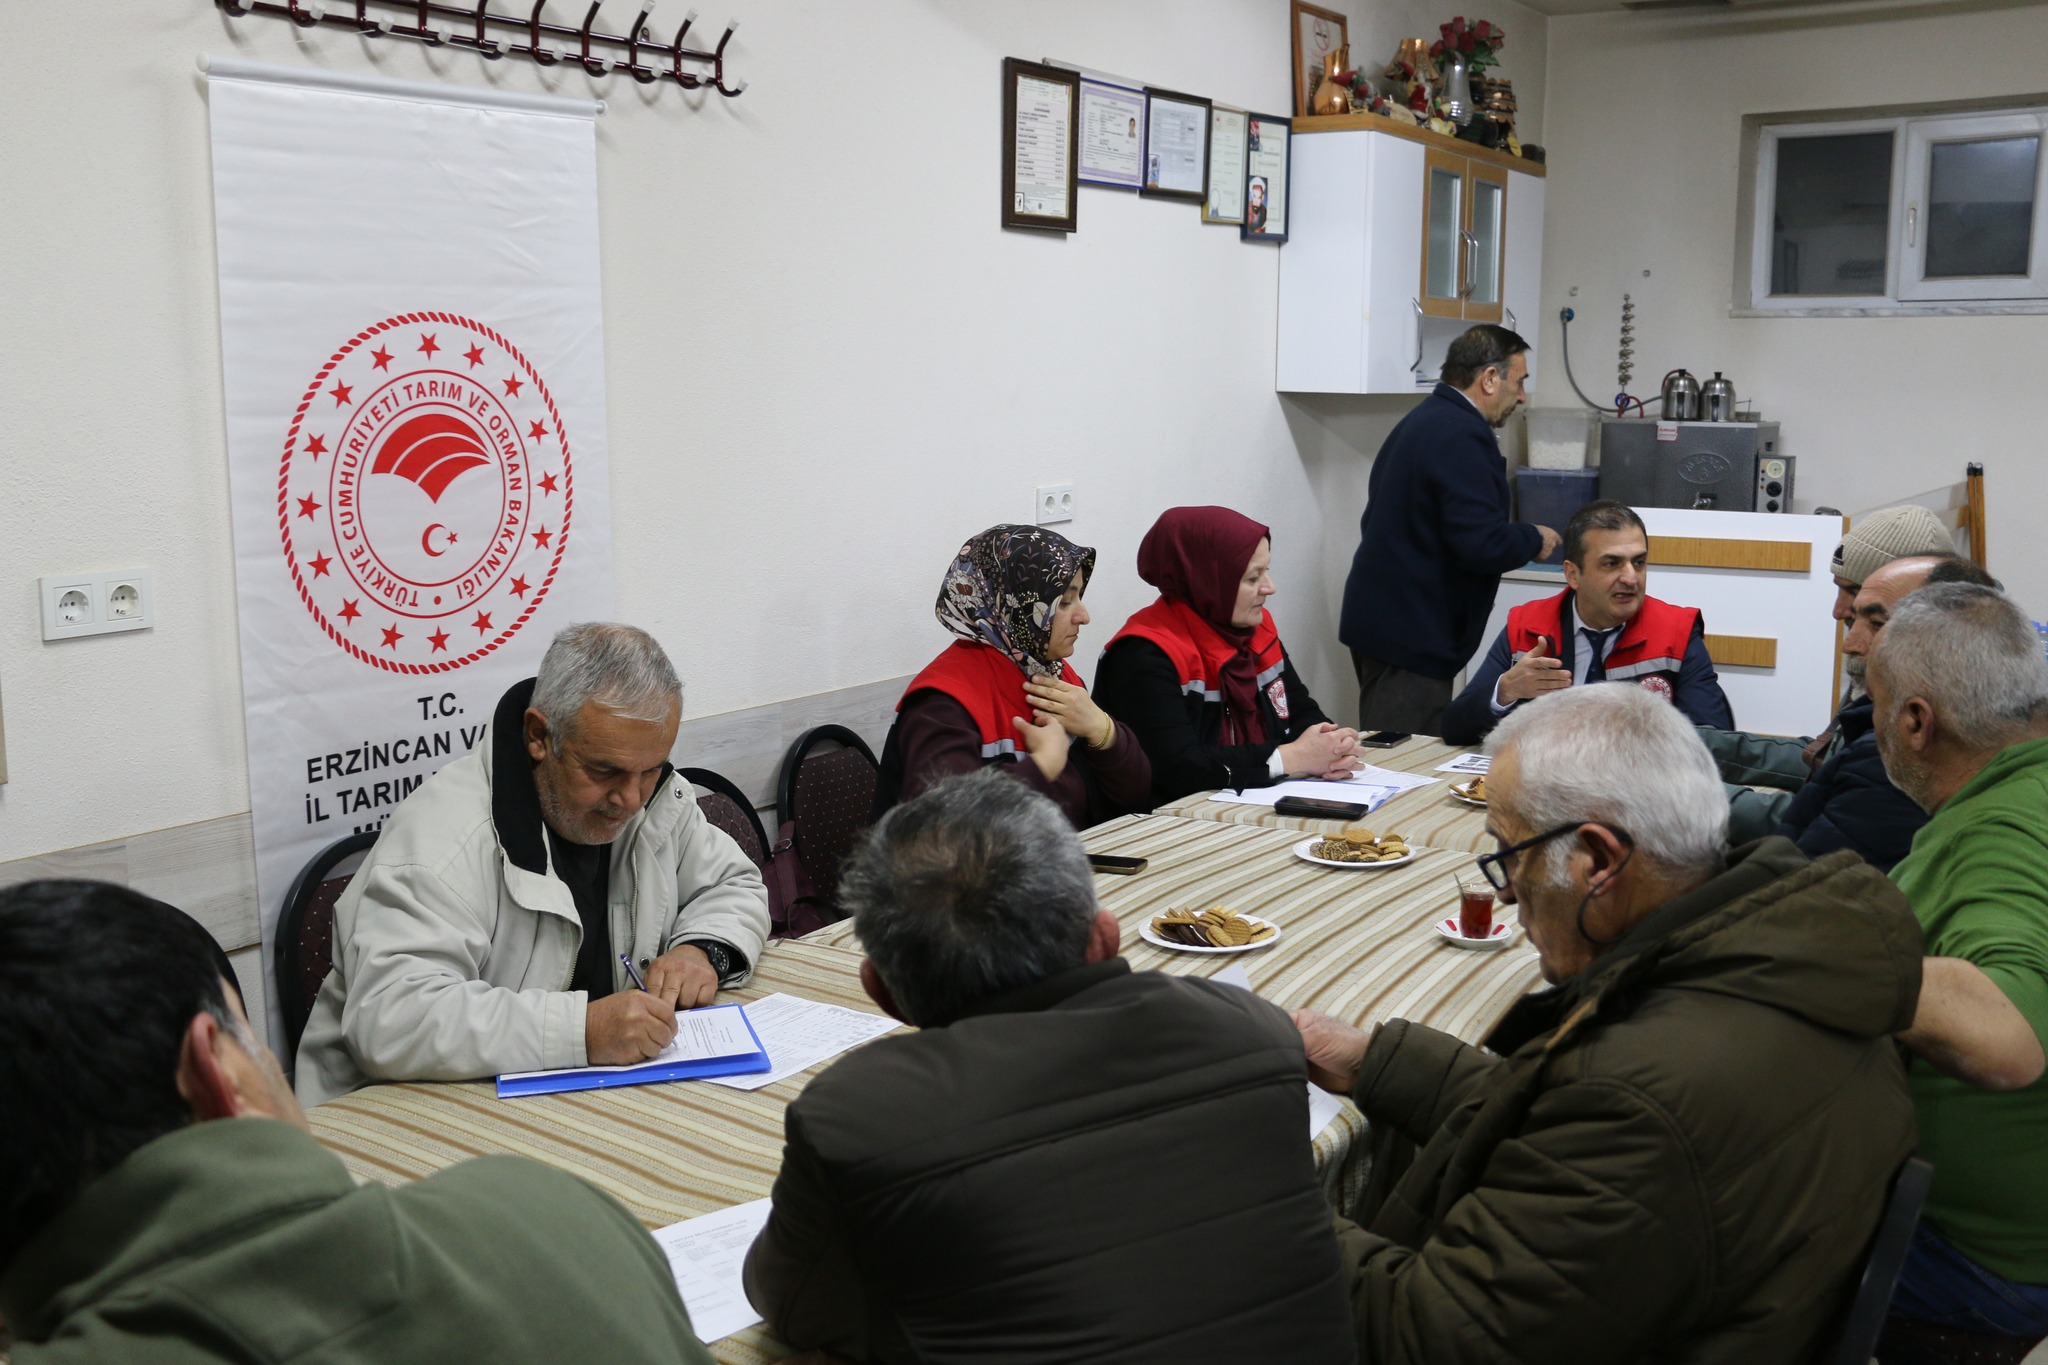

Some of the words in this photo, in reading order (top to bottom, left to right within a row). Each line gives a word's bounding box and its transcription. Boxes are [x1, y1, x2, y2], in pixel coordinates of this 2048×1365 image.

[402, 379, 463, 403] TARIM
[468, 391, 490, 417] VE
[338, 389, 400, 541] CUMHURİYETİ
[489, 415, 523, 490] ORMAN
[349, 545, 419, 608] TÜRKİYE
[456, 500, 523, 600] BAKANLIĞI
[417, 693, 464, 721] T.C.
[307, 730, 451, 784] ERZİNCAN
[306, 793, 330, 825] İL
[337, 774, 423, 815] TARIM
